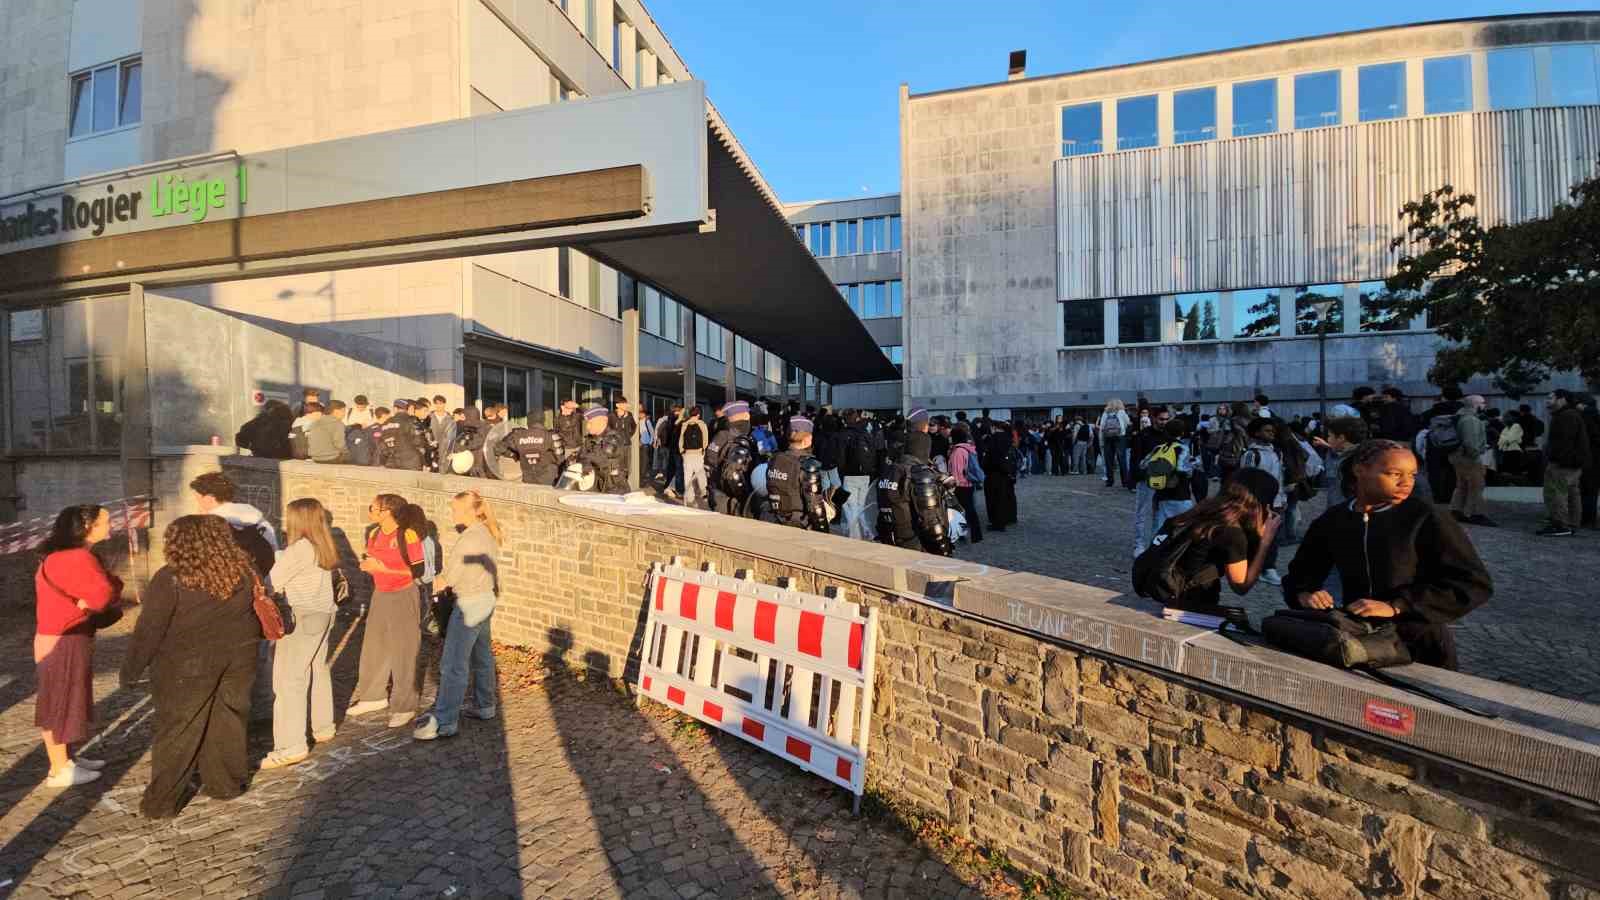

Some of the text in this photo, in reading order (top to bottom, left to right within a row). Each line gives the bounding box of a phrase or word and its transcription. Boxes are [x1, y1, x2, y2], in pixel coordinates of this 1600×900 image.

[61, 184, 142, 236] Rogier
[151, 174, 225, 222] Liège
[233, 164, 247, 205] 1
[1007, 600, 1120, 651] JEUNESSE
[1141, 637, 1178, 672] EN
